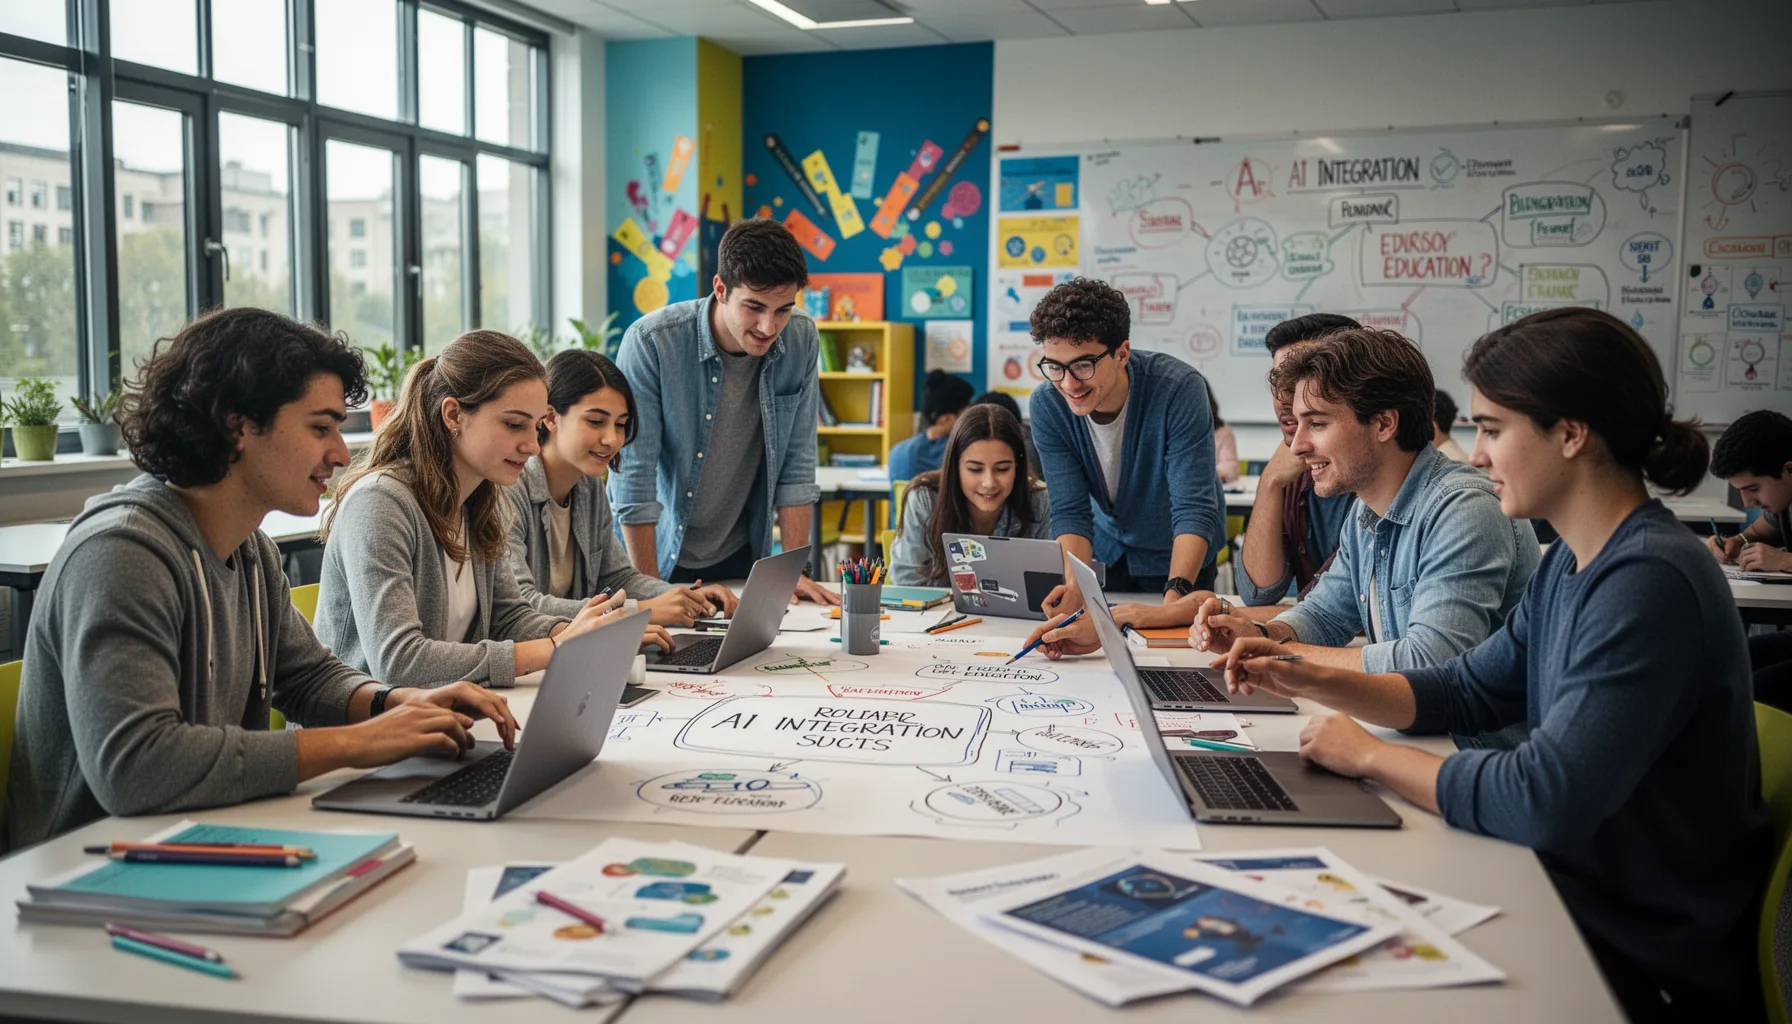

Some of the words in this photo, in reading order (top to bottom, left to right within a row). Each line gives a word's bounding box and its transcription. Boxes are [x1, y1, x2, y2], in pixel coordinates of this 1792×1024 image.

[1288, 159, 1307, 187] AI
[1318, 156, 1420, 186] INTEGRATION
[1384, 256, 1472, 279] EDUCATION
[711, 712, 758, 730] AI
[775, 716, 964, 740] INTEGRATION
